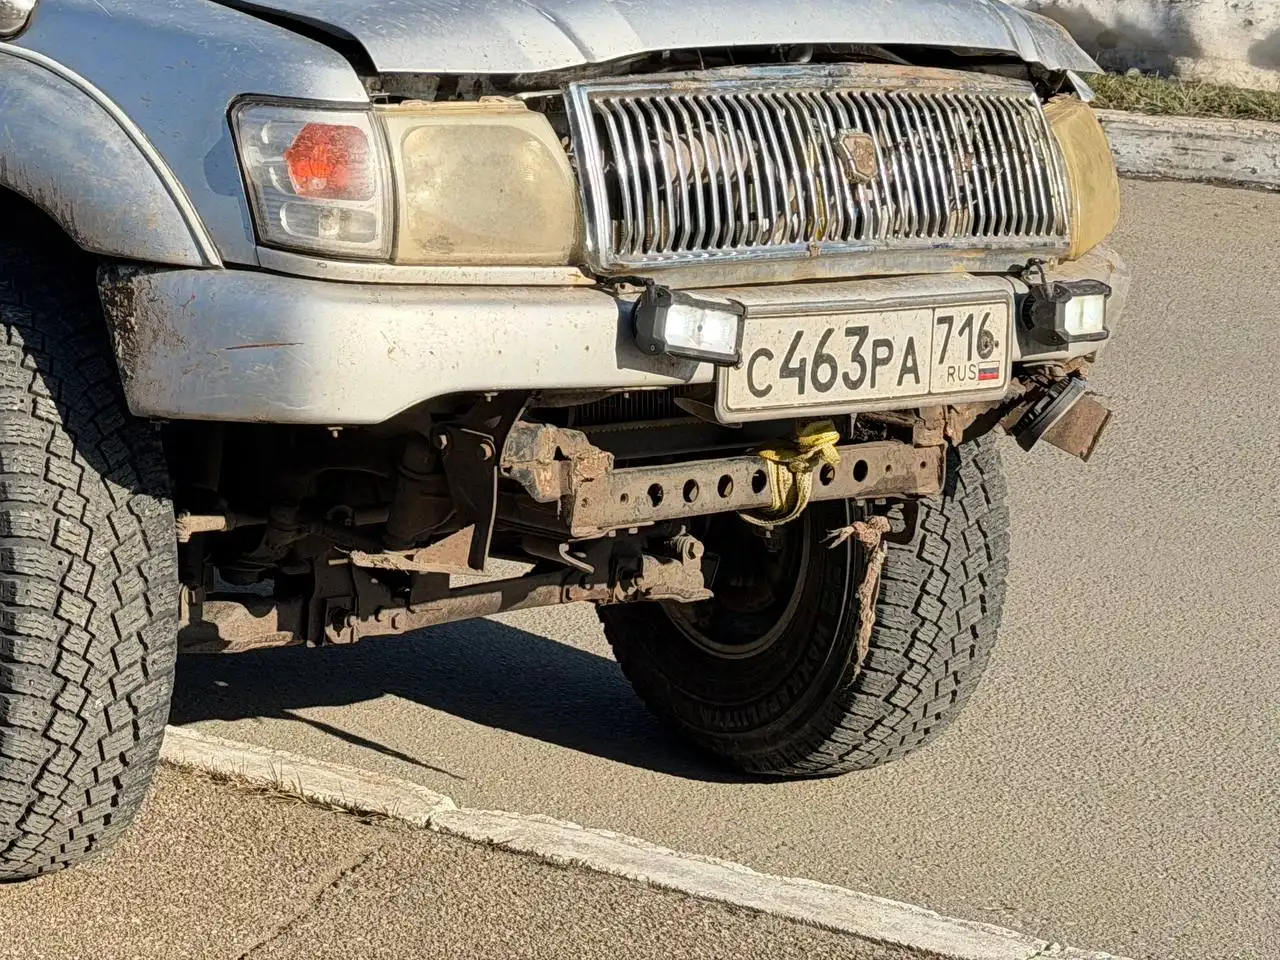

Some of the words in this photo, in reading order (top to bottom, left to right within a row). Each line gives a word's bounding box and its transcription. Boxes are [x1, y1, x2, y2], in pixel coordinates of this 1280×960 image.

[746, 325, 921, 398] С463РА
[936, 312, 993, 365] 716
[947, 364, 977, 383] RUS
